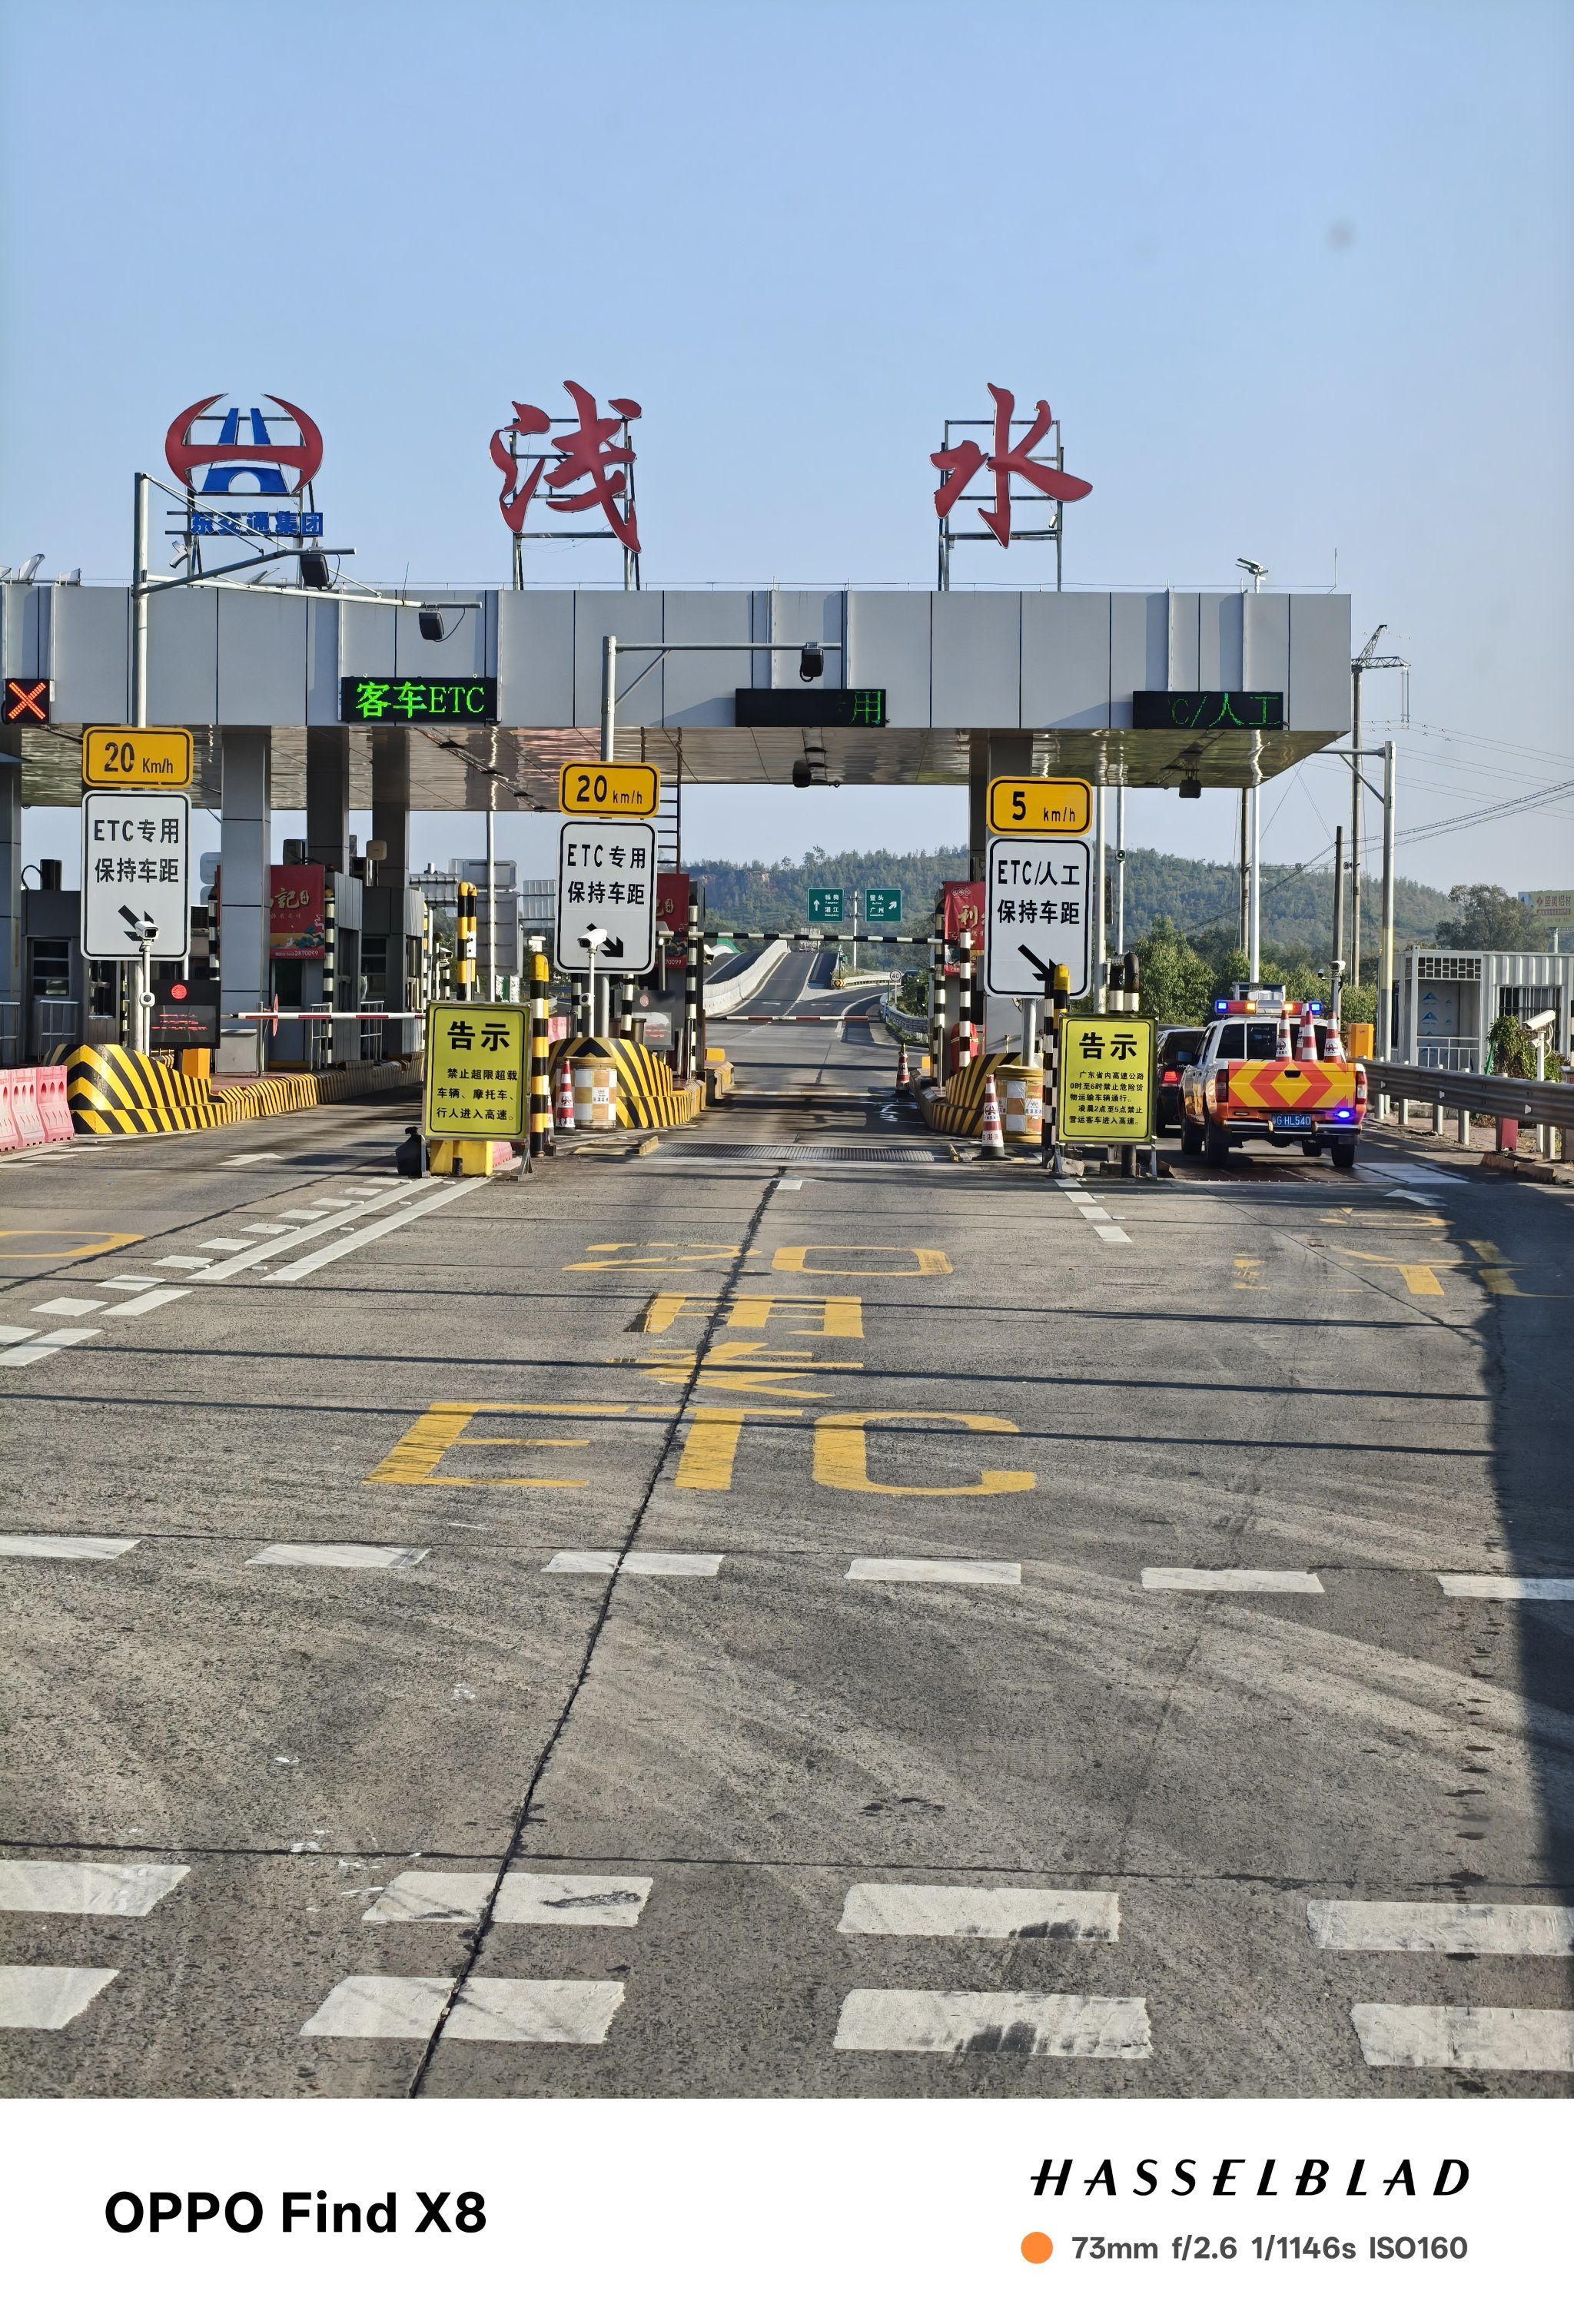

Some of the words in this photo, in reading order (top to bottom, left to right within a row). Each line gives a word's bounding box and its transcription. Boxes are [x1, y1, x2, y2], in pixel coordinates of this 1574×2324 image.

[356, 682, 484, 718] 客车ETC
[105, 742, 134, 772] 20
[577, 775, 606, 802] 20
[613, 788, 643, 805] km/h
[1012, 791, 1026, 821] 5
[1044, 807, 1075, 822] km/h
[95, 818, 179, 844] ETC专用
[568, 844, 646, 869] ETC专用
[95, 858, 179, 884] 保持车距
[998, 860, 1079, 885] ETC/人工
[270, 887, 300, 908] 記
[568, 881, 645, 905] 保持车距
[958, 905, 985, 928] 利
[998, 898, 1080, 925] 保持车距
[447, 1021, 510, 1052] 告示
[1078, 1032, 1137, 1061] 告示
[447, 1067, 518, 1081] 禁止超限超载
[1070, 1082, 1144, 1091] 0时至6时禁止危险货
[1079, 1071, 1144, 1080] 广东省内高速公路
[1078, 1104, 1143, 1114] 凌晨2点至5点禁止
[563, 1243, 954, 1276] 20
[362, 1403, 1037, 1496] ETC
